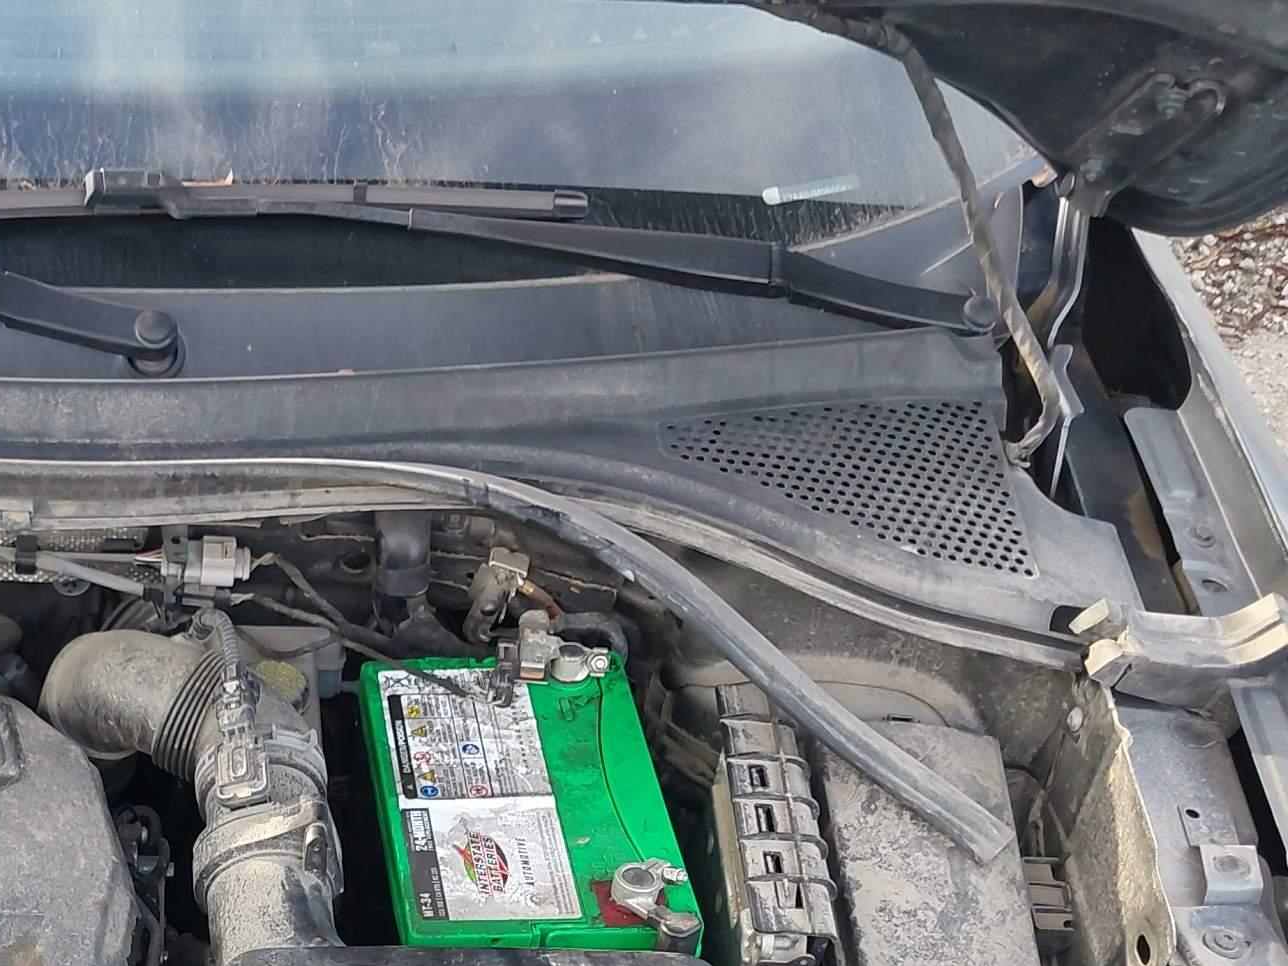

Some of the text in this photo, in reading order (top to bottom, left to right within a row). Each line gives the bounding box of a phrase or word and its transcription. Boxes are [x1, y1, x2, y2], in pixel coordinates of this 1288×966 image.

[411, 811, 429, 852] 24-MONTH
[469, 832, 491, 895] INTERSTATE
[483, 837, 505, 893] BATTERIES
[516, 838, 535, 887] AUTOMOTIVE
[419, 893, 434, 918] MT-34
